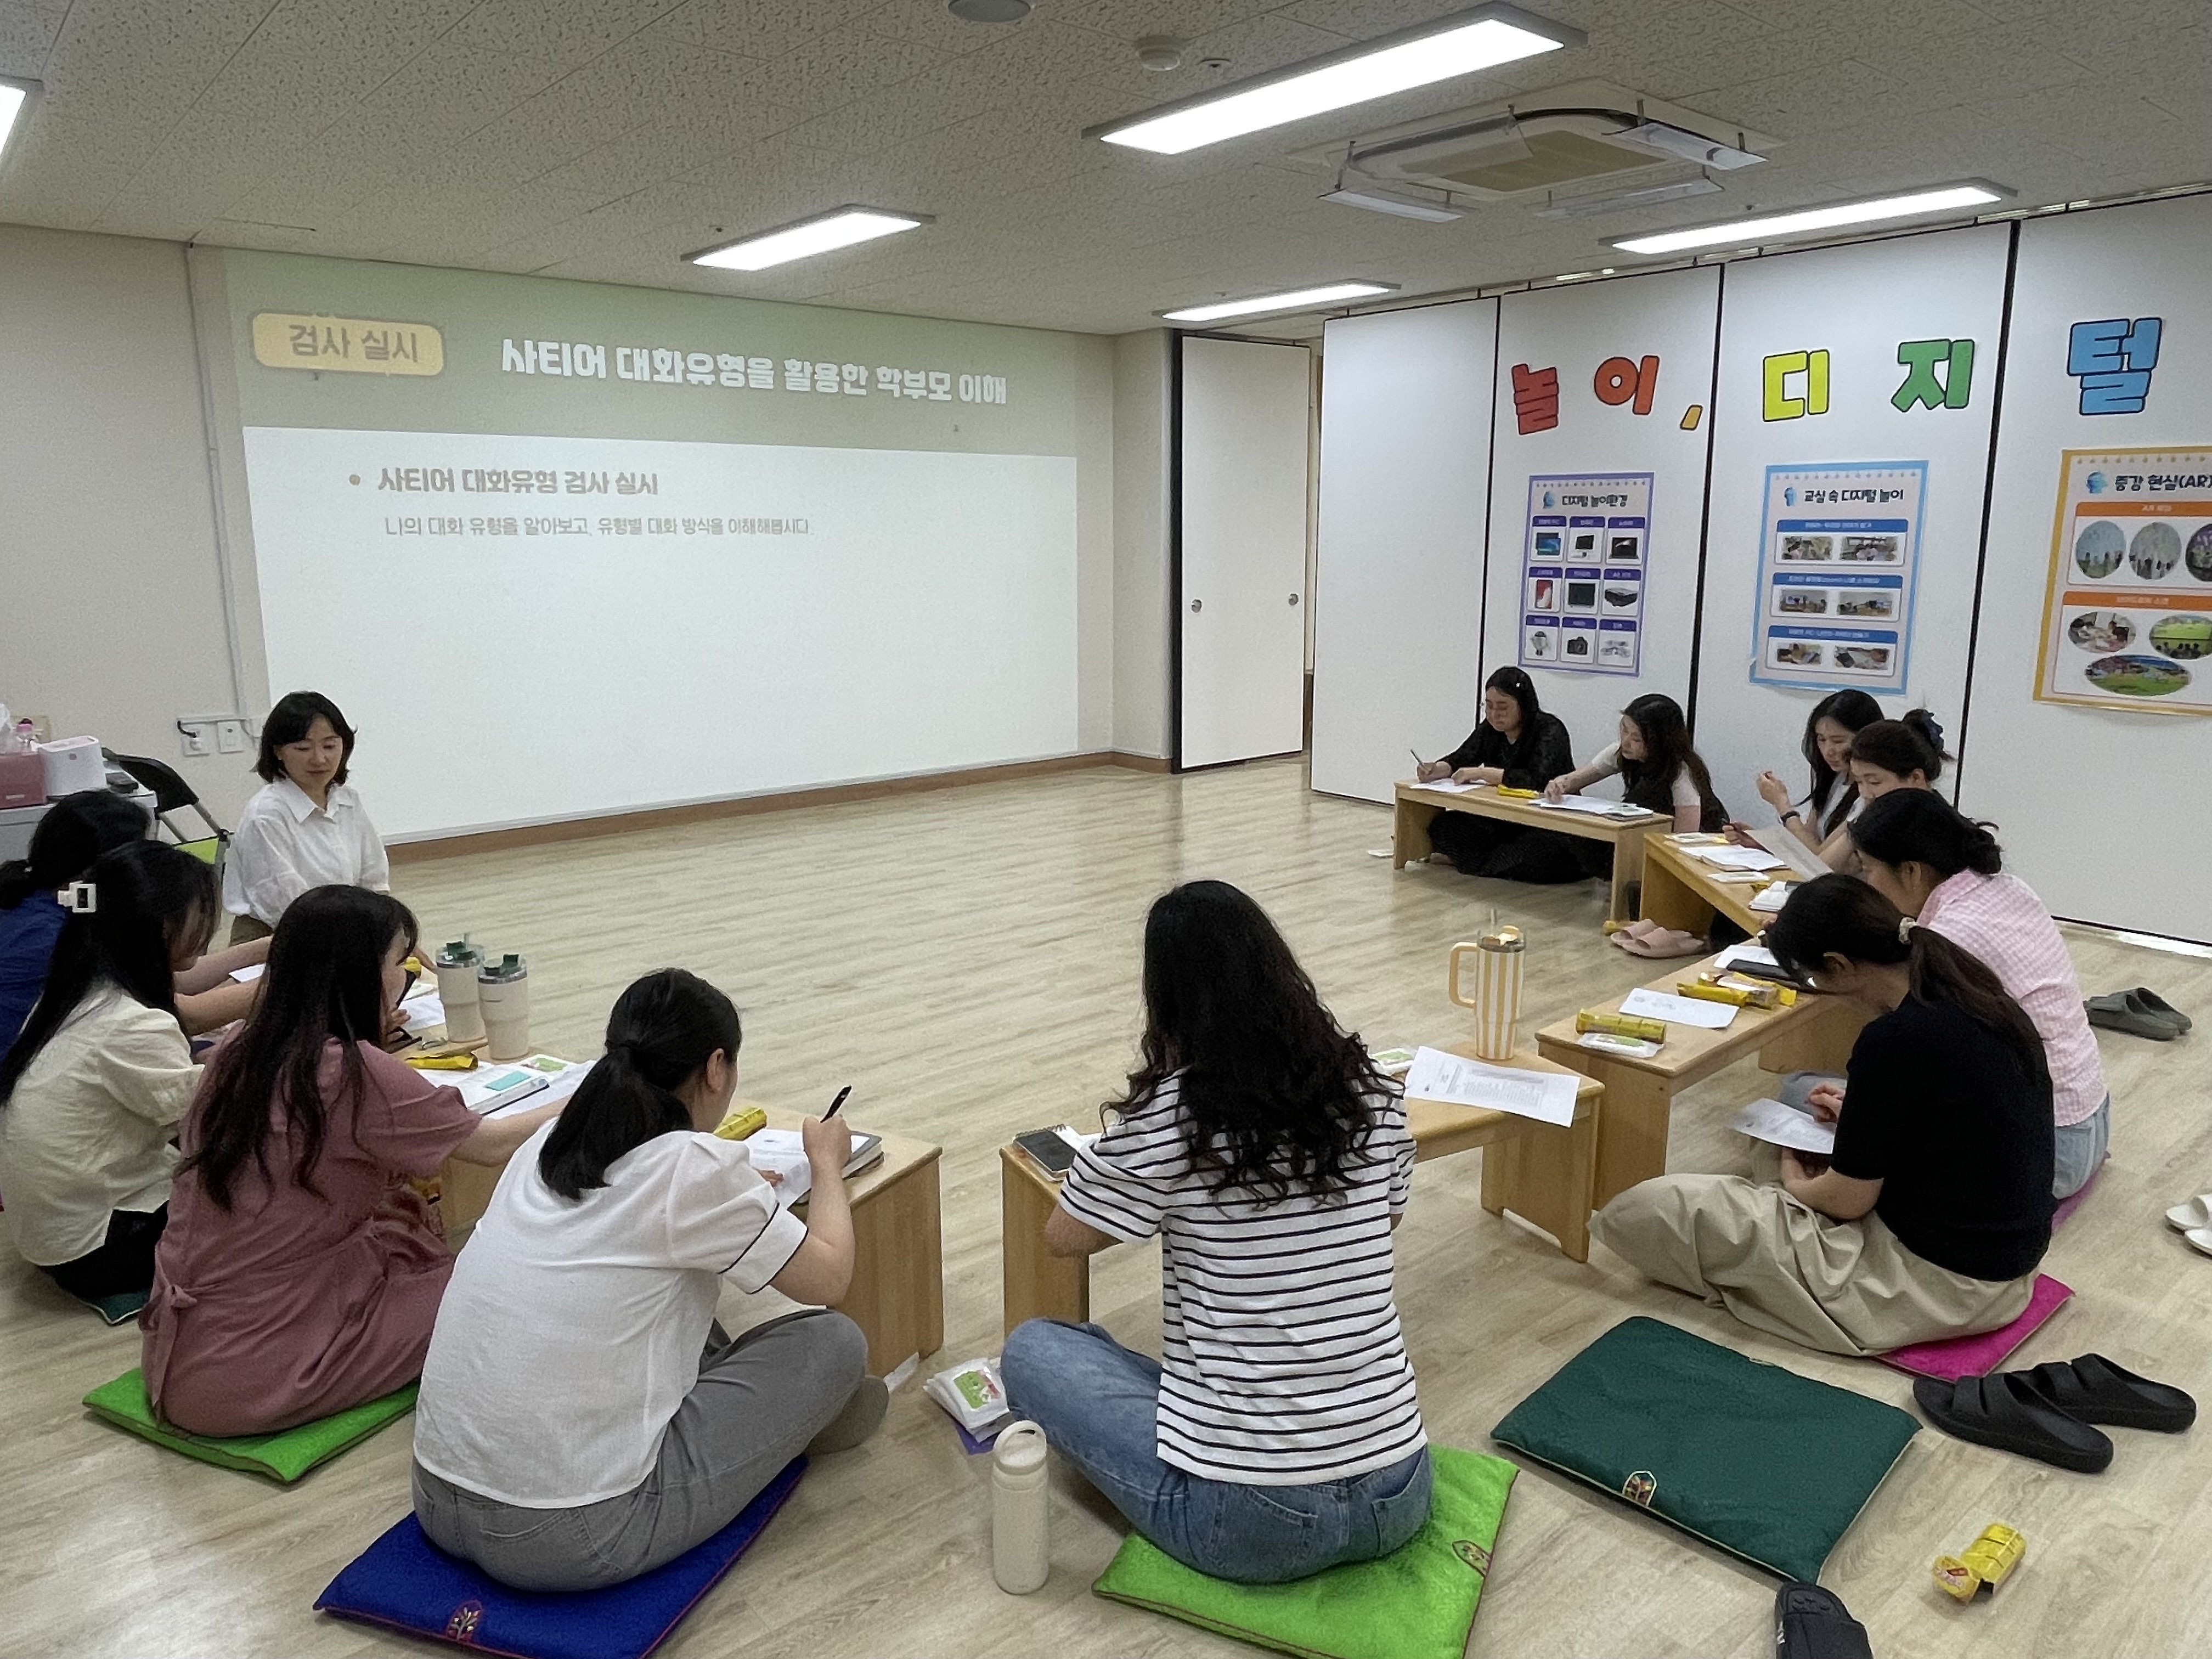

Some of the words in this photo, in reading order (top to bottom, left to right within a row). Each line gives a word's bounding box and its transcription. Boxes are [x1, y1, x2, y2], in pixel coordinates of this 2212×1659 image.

[289, 324, 350, 358] 검사
[361, 330, 418, 363] 실시
[502, 338, 606, 379] 사티어
[616, 347, 774, 389] 대화유형을
[784, 358, 868, 396] 활용한
[876, 365, 952, 401] 학부모
[958, 374, 1007, 404] 이해
[1762, 317, 2163, 422] 디지털
[378, 467, 455, 492] 사티어
[462, 469, 558, 494] 대화유형
[564, 470, 610, 494] 검사
[614, 471, 659, 495] 실시
[385, 517, 421, 535] 나의
[428, 517, 464, 536] 대화
[470, 517, 518, 536] 유형을
[523, 517, 592, 537] 알아보고,
[598, 517, 643, 535] 유형별
[647, 517, 678, 534] 대화
[682, 517, 724, 535] 방식을
